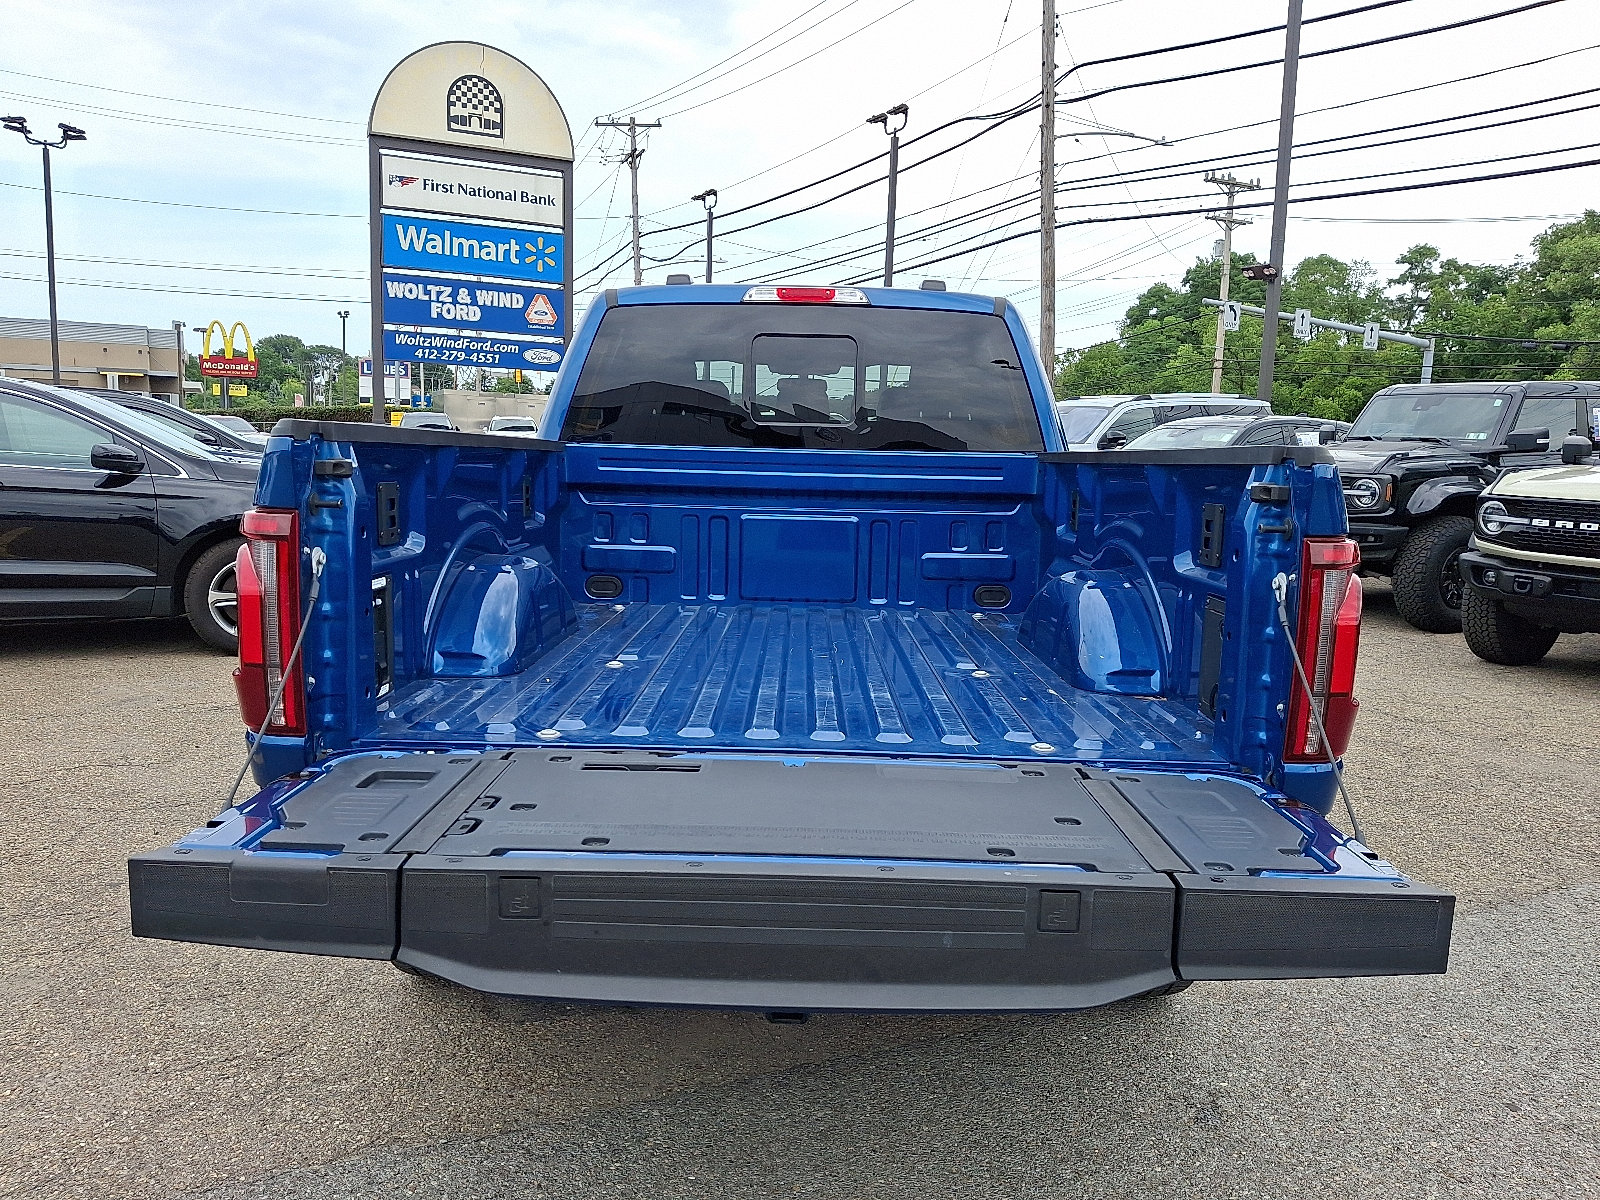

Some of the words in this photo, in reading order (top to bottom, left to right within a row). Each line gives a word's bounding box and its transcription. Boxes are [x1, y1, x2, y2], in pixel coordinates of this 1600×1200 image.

[422, 179, 454, 195] First
[457, 183, 517, 202] National
[520, 191, 556, 207] Bank
[395, 224, 520, 264] Walmart
[386, 281, 453, 302] WOLTZ
[458, 288, 472, 304] &
[475, 289, 525, 308] WIND
[430, 302, 482, 322] FORD
[395, 333, 519, 353] WoltzWindFord.com
[202, 361, 255, 371] McDonald's
[414, 349, 500, 364] 412-279-4551
[530, 351, 554, 362] Ford
